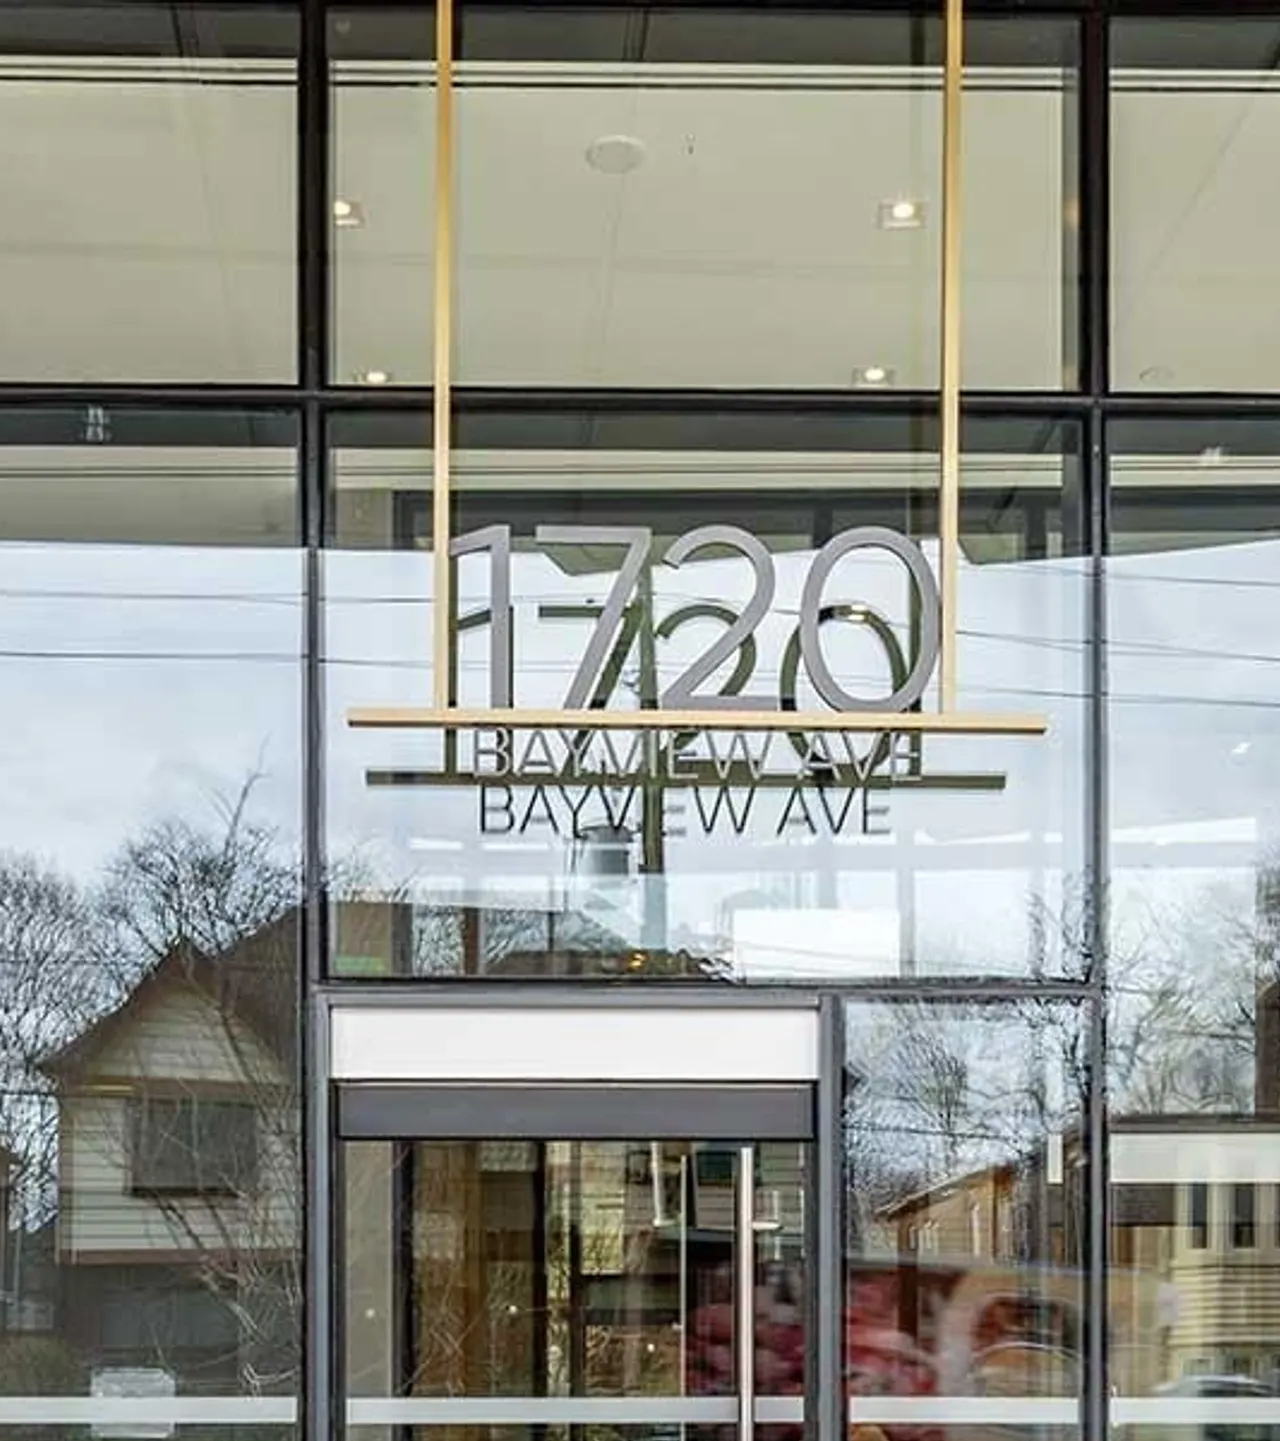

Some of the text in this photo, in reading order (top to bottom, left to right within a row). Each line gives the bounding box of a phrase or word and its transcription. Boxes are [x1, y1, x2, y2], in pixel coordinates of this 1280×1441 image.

[449, 524, 941, 712] 1720
[472, 728, 923, 781] BAYVIEW AVE
[478, 784, 891, 835] BAYVEW AVE
